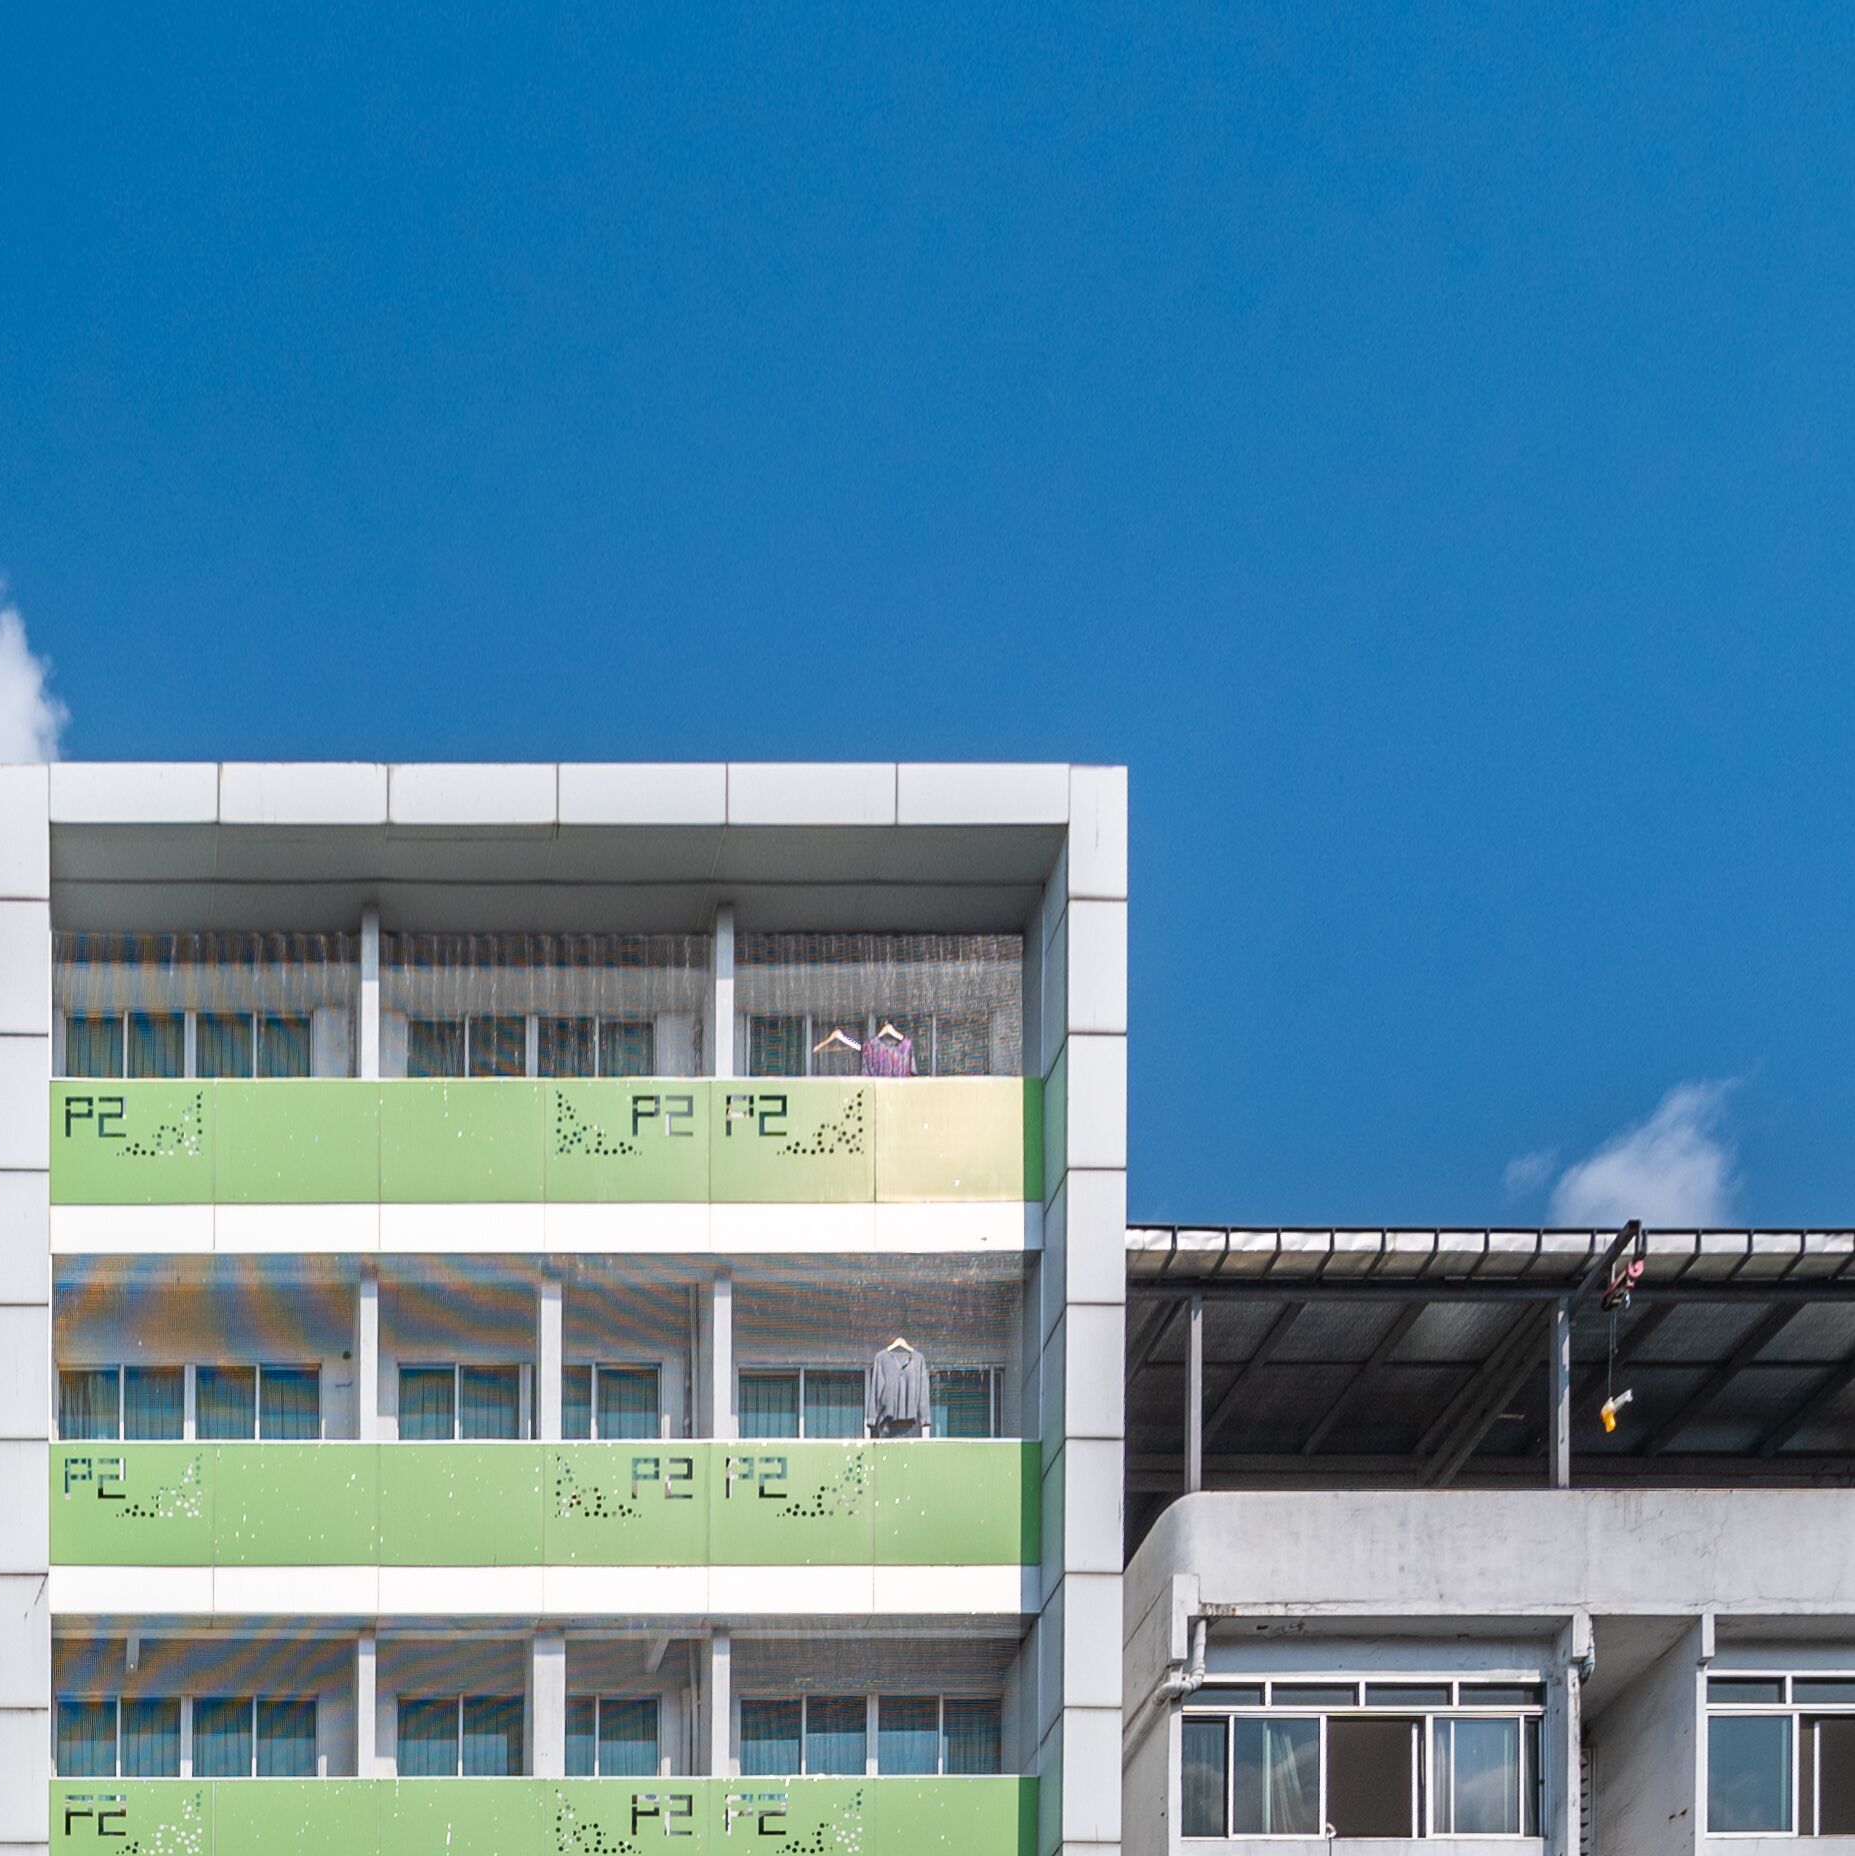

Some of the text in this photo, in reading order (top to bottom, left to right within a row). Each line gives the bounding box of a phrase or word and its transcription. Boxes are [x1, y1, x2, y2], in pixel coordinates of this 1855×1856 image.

[64, 1094, 126, 1137] P2
[631, 1094, 693, 1137] P2
[724, 1094, 786, 1137] P2
[64, 1456, 126, 1499] P2
[631, 1456, 693, 1499] P2
[724, 1456, 786, 1499] P2
[64, 1795, 126, 1838] P2
[631, 1795, 693, 1838] P2
[724, 1795, 786, 1838] P2
